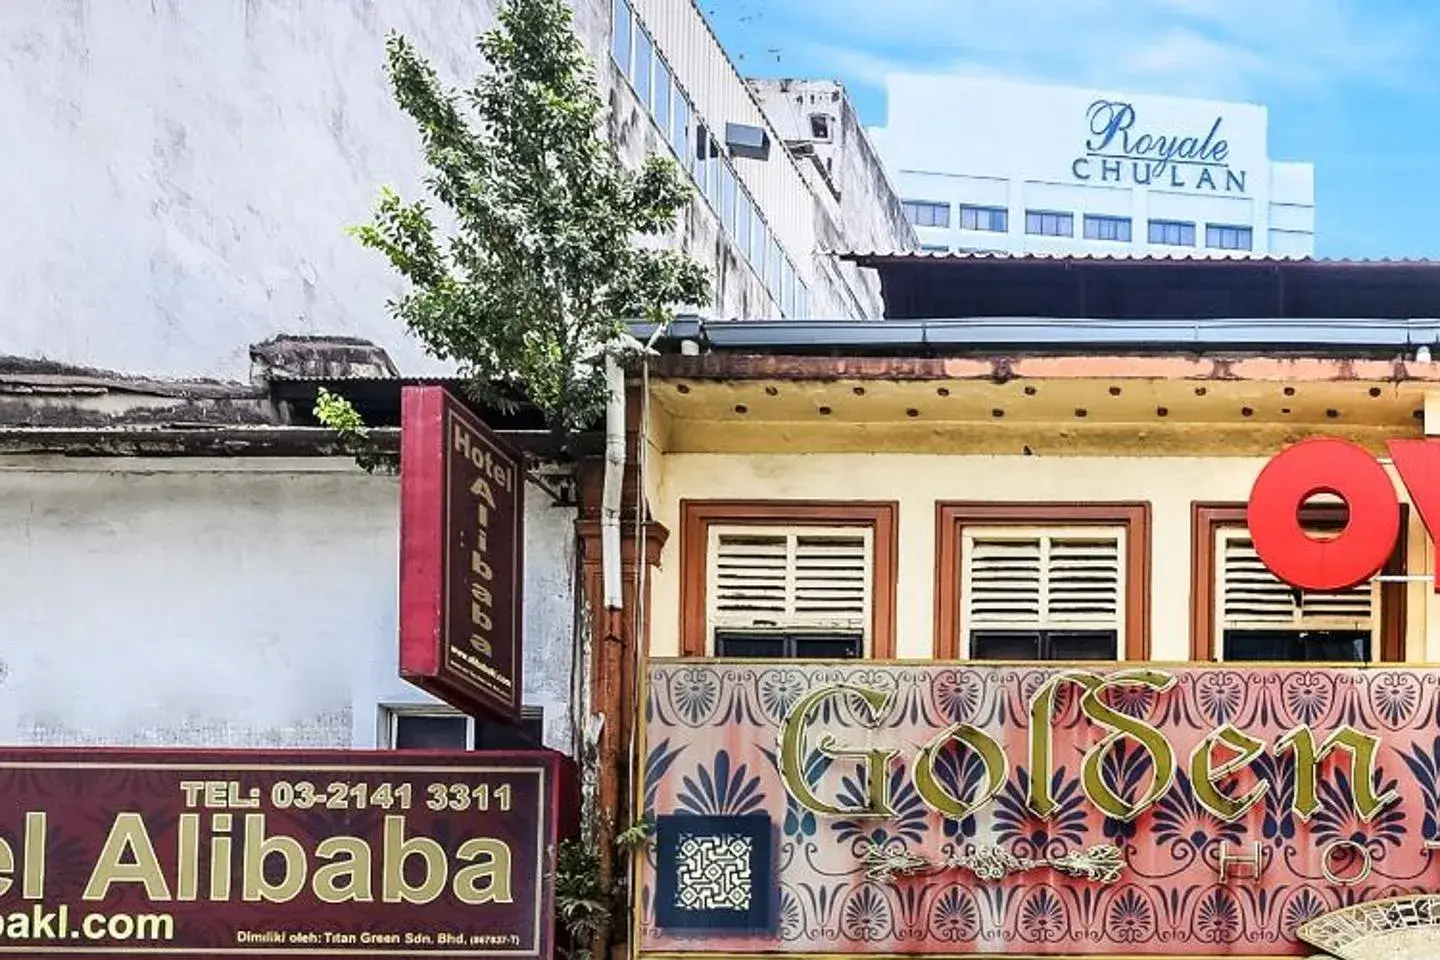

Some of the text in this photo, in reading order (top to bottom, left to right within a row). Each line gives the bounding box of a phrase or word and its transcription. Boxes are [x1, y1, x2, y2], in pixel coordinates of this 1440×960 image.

[1086, 99, 1230, 178] Royale
[1071, 157, 1247, 193] CHULAN
[453, 422, 512, 493] Hotel
[469, 477, 496, 658] Alibaba
[777, 669, 1401, 824] Golden
[180, 781, 513, 811] TEL: 03-2141 3311
[82, 811, 514, 904] Alibaba
[0, 904, 174, 940] akl.com
[325, 931, 356, 944] Titan
[360, 932, 401, 945] Green
[404, 932, 435, 945] Sdn.
